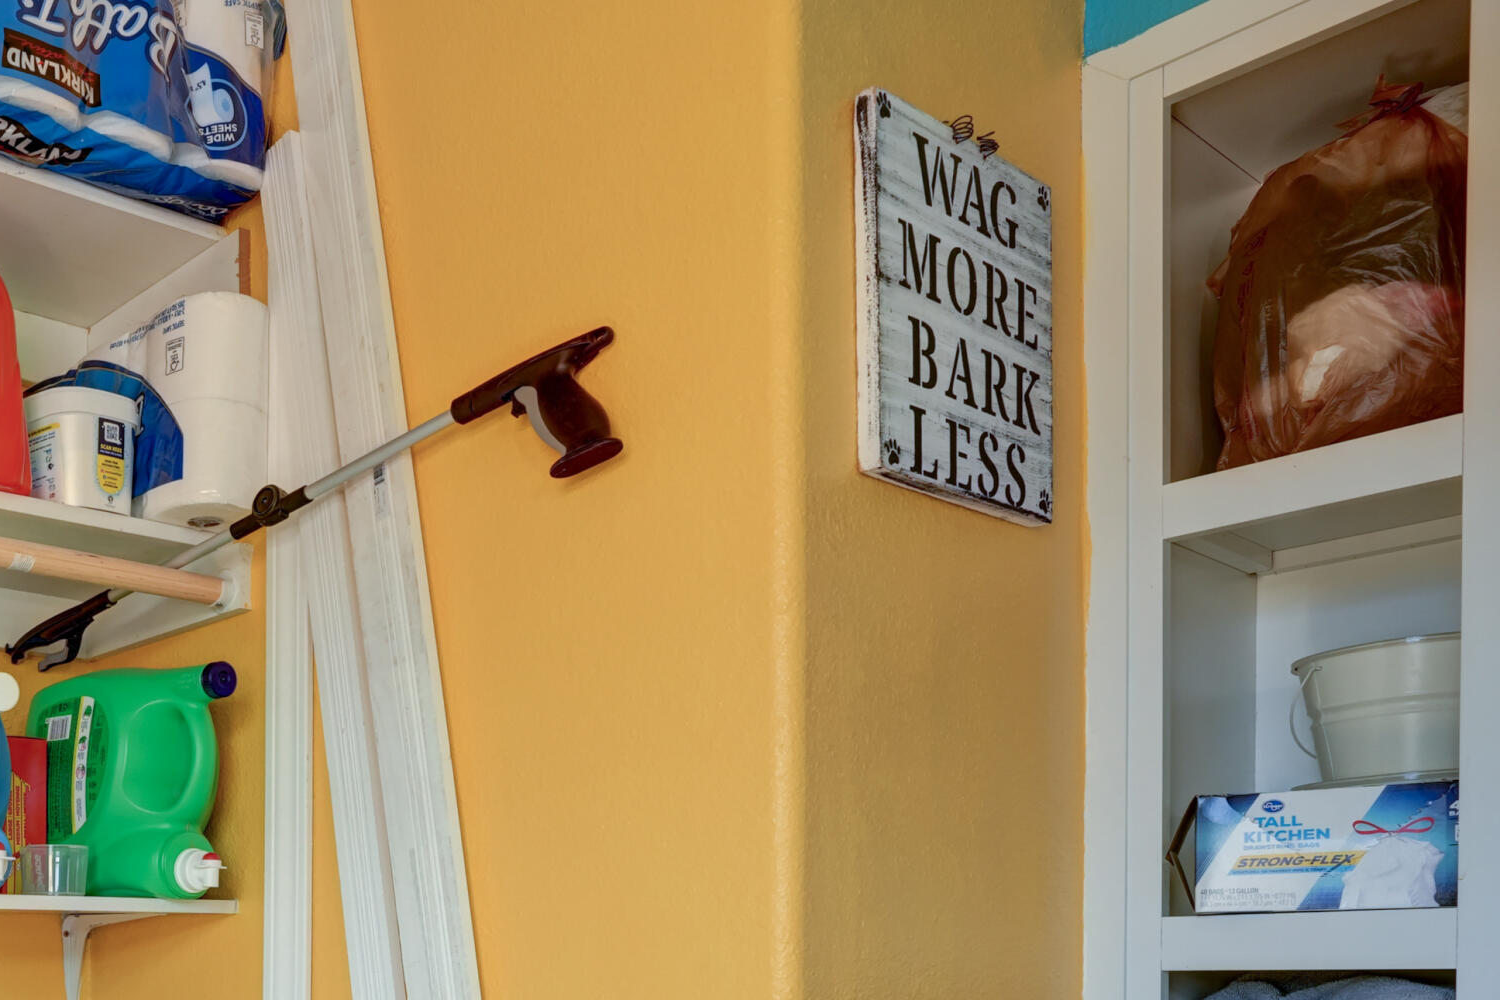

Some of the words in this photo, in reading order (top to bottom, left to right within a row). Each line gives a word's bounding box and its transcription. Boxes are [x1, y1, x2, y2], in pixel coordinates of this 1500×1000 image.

[7, 48, 94, 104] KIRKLAND
[198, 123, 238, 136] SHEETS
[206, 133, 235, 144] WIDE
[912, 132, 1019, 249] WAG
[898, 218, 1039, 351] MORE
[908, 315, 1041, 436] BARK
[910, 405, 1027, 507] LESS
[1263, 802, 1283, 811] Kroger
[1254, 816, 1303, 828] TALL
[1244, 828, 1330, 843] KITCHEN
[1238, 854, 1355, 868] STRONG-FLEX
